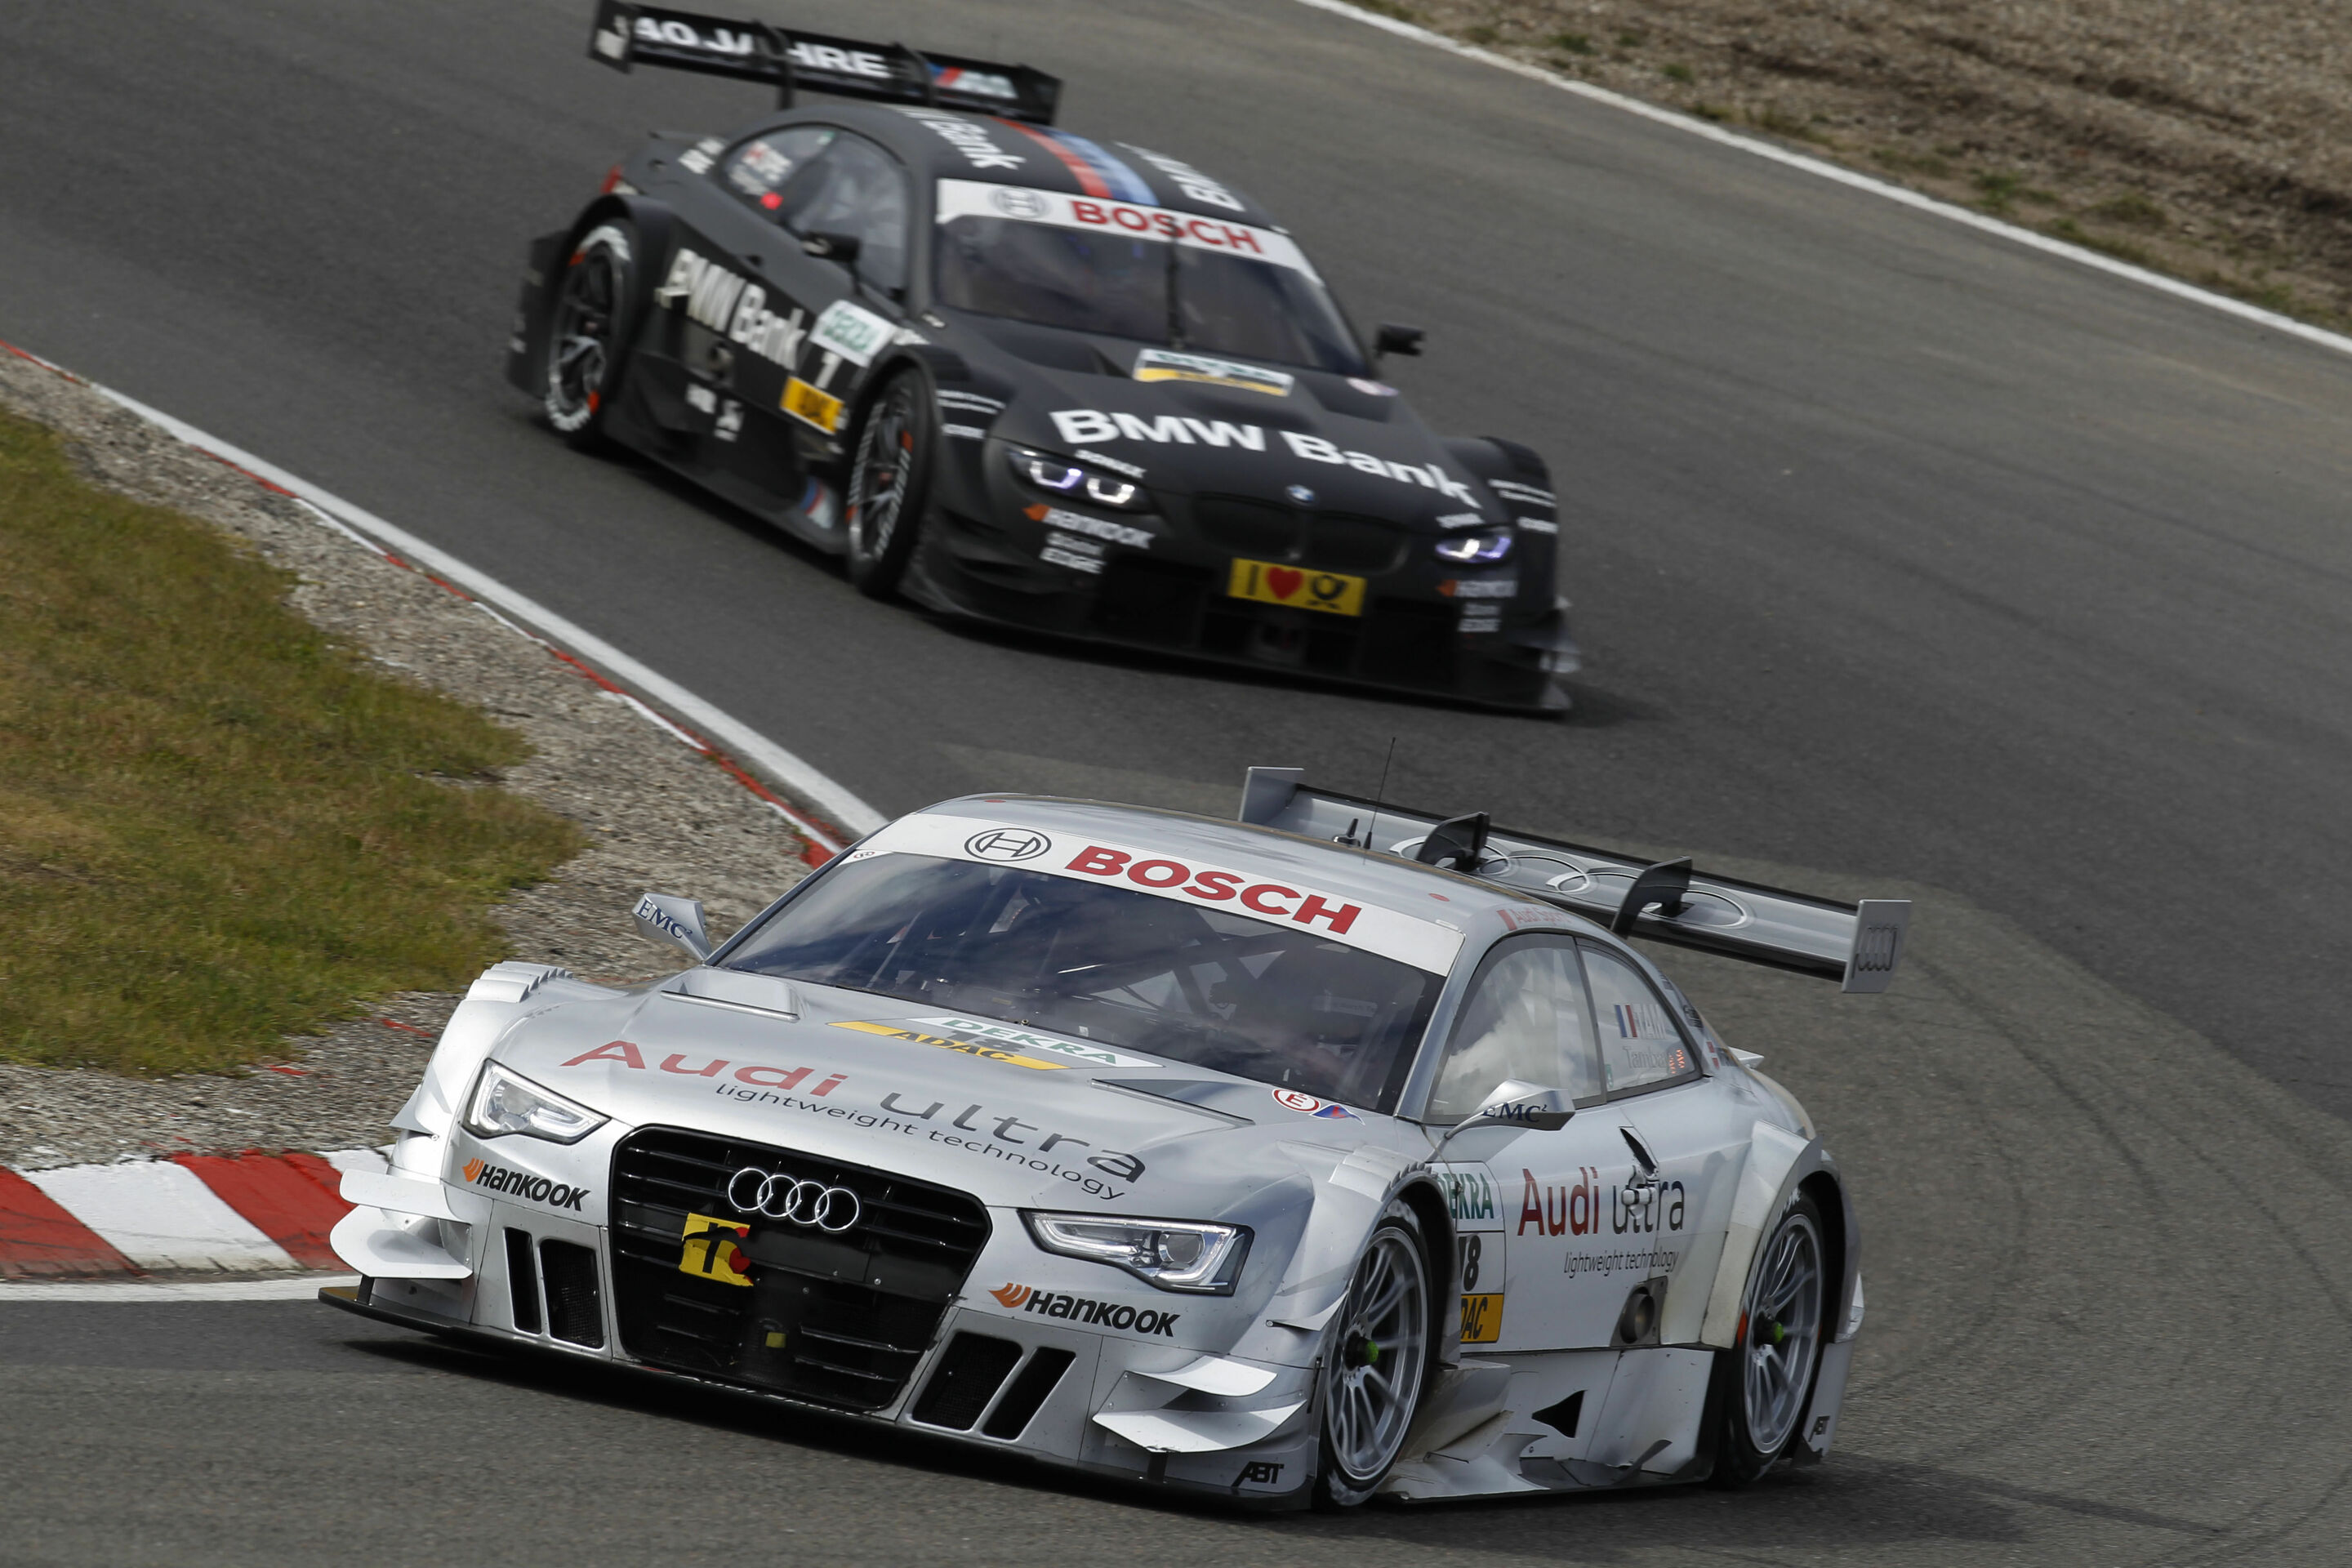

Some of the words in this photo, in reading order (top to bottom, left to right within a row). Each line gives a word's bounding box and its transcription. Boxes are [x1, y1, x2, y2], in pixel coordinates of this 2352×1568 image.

[1070, 199, 1263, 255] BOSCH
[1050, 408, 1266, 453] BMW
[1276, 429, 1483, 510] Bank
[1065, 845, 1362, 935] BOSCH
[889, 1031, 1015, 1061] ADAC
[941, 1018, 1117, 1064] DEKRA
[559, 1040, 849, 1097] Audi
[880, 1091, 1147, 1184] ultra
[716, 1083, 914, 1136] lightweight
[928, 1129, 1126, 1201] technology
[1517, 1166, 1600, 1236] Audi
[1564, 1250, 1624, 1279] lightweight
[1625, 1245, 1679, 1272] technology
[1231, 1461, 1285, 1487] ABT
